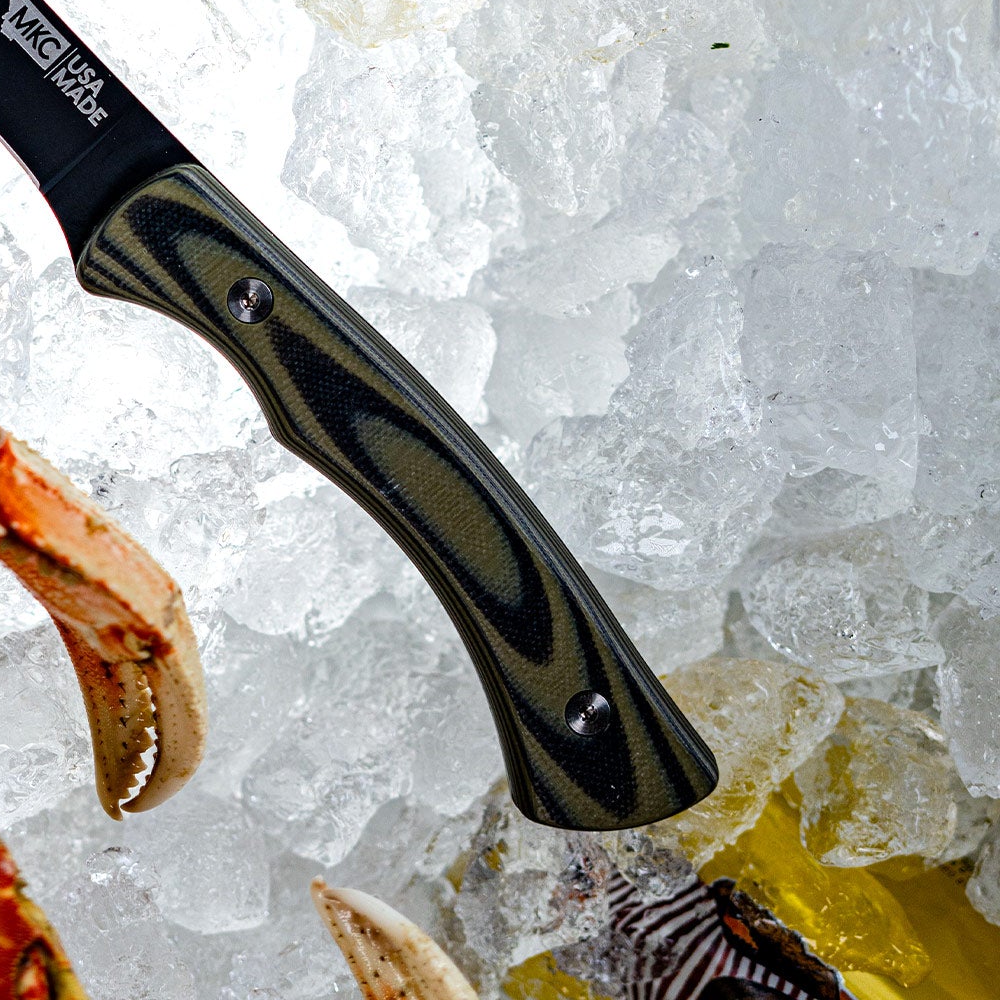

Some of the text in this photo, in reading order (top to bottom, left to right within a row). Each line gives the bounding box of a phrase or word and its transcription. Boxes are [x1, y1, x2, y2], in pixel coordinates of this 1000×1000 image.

[8, 4, 62, 61] MKC
[50, 67, 109, 128] MADE
[67, 54, 105, 99] USA
